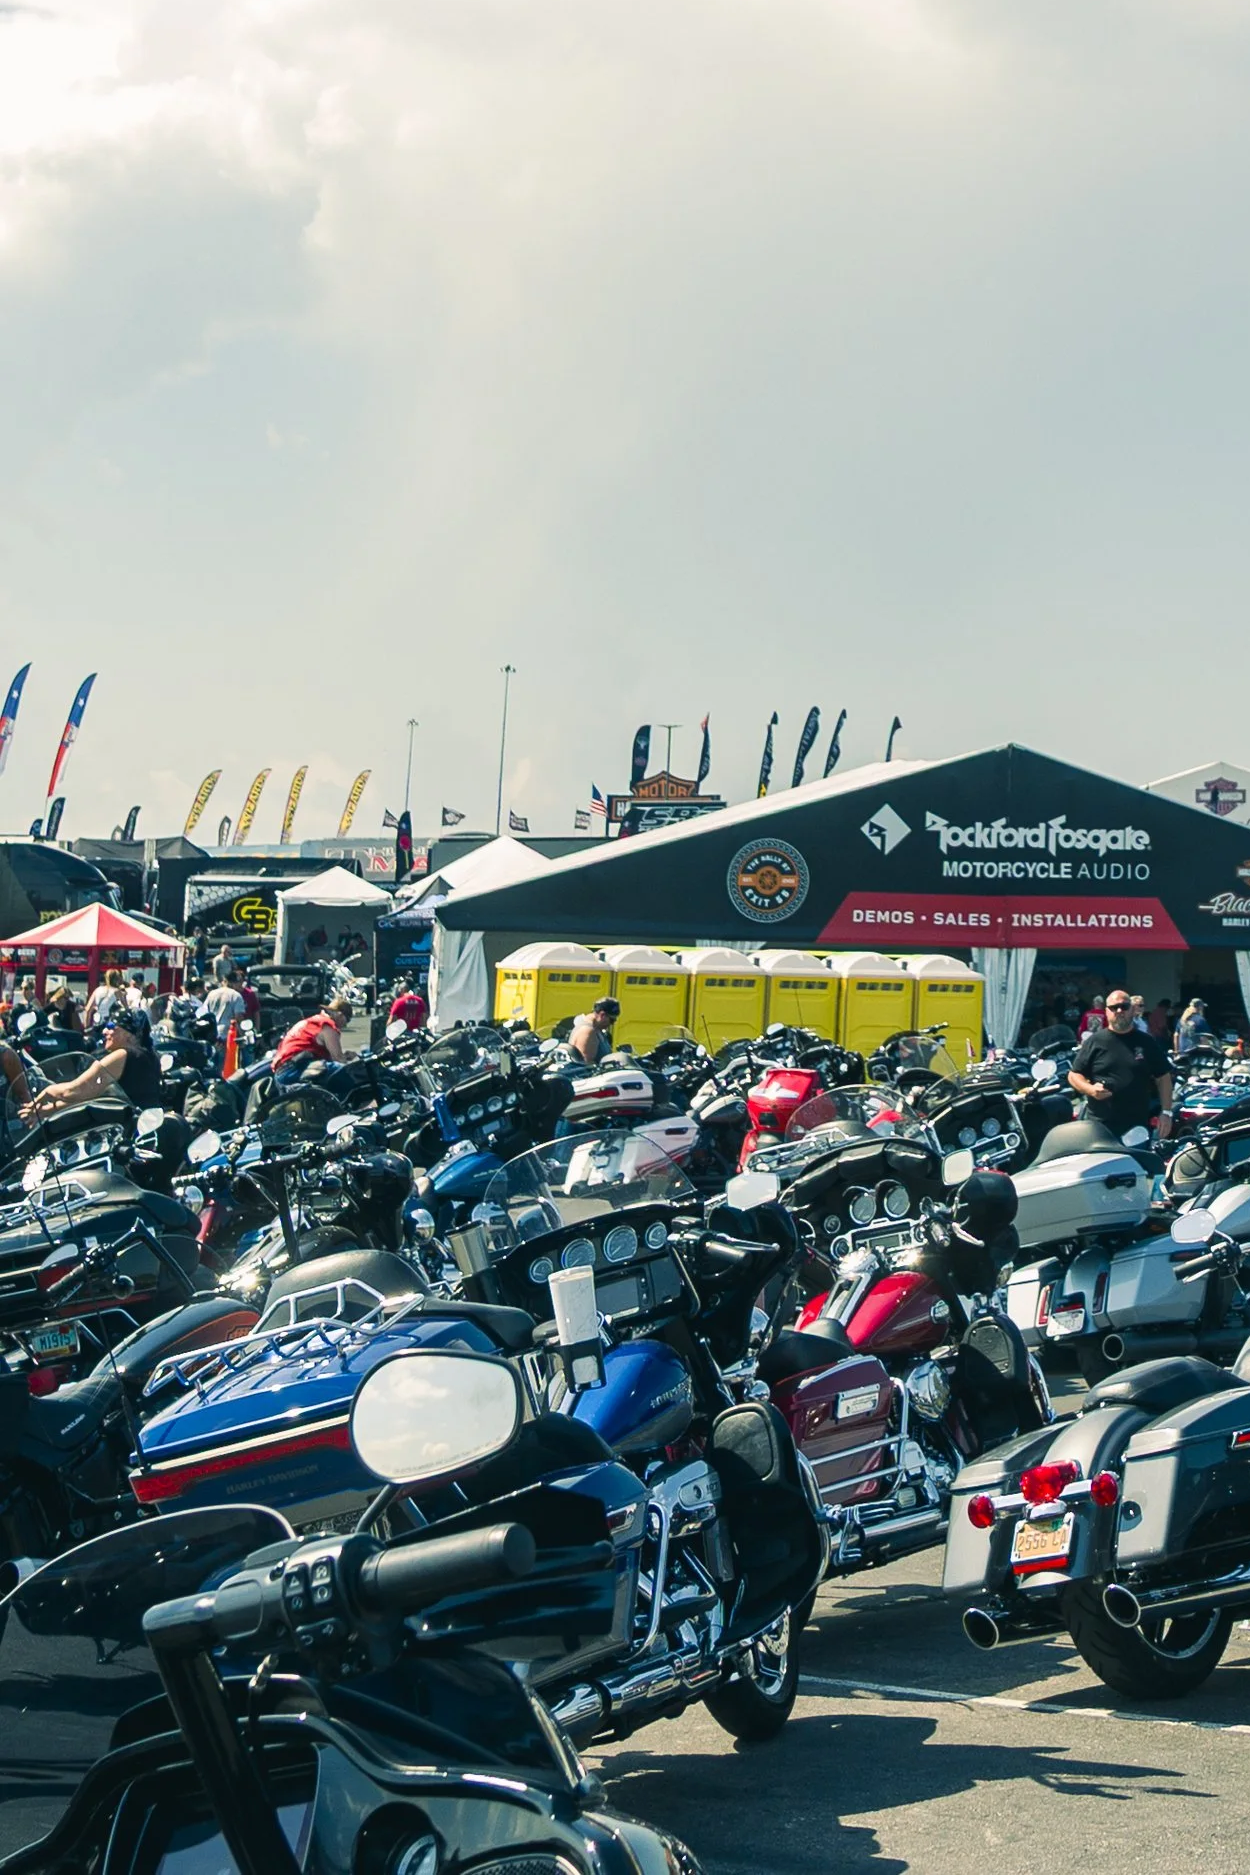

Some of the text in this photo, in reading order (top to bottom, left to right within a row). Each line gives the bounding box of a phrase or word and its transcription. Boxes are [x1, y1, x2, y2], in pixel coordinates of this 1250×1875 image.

[925, 810, 1046, 855] Rockford
[942, 861, 1151, 880] MOTORCYCLE AUDIO
[745, 888, 770, 907] EXIT
[852, 909, 1154, 929] DEMOS SALES INSTALLATIONS
